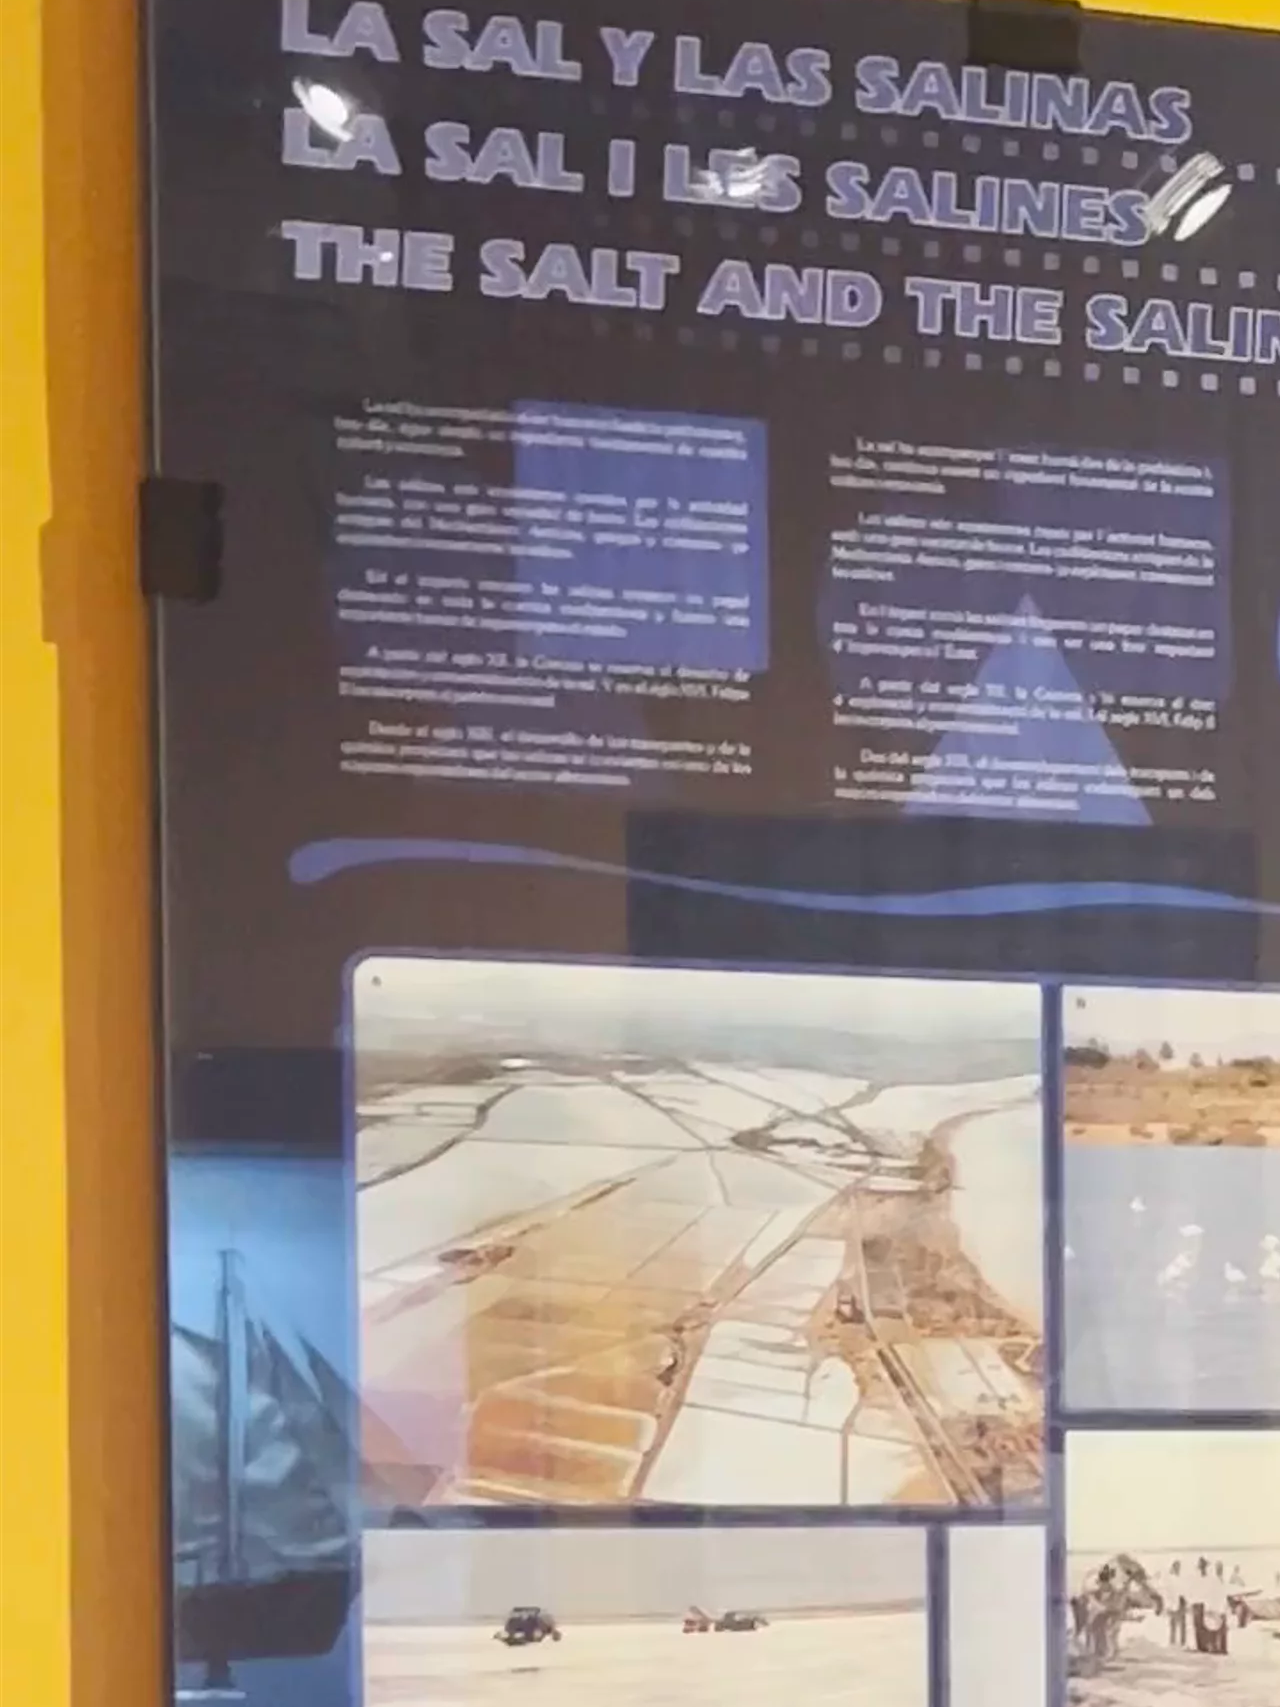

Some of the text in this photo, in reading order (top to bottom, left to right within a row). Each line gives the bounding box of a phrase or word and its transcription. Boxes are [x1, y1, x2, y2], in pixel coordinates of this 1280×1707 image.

[422, 9, 583, 80] SAL
[599, 26, 655, 87] Y
[674, 35, 832, 107] LAS
[854, 55, 1193, 144] SALINAS
[281, 106, 1151, 246] LA SAL I LES SALINES
[280, 219, 455, 292] THE
[479, 238, 681, 310] SALT
[696, 259, 883, 328] AND
[904, 276, 1064, 345] THE
